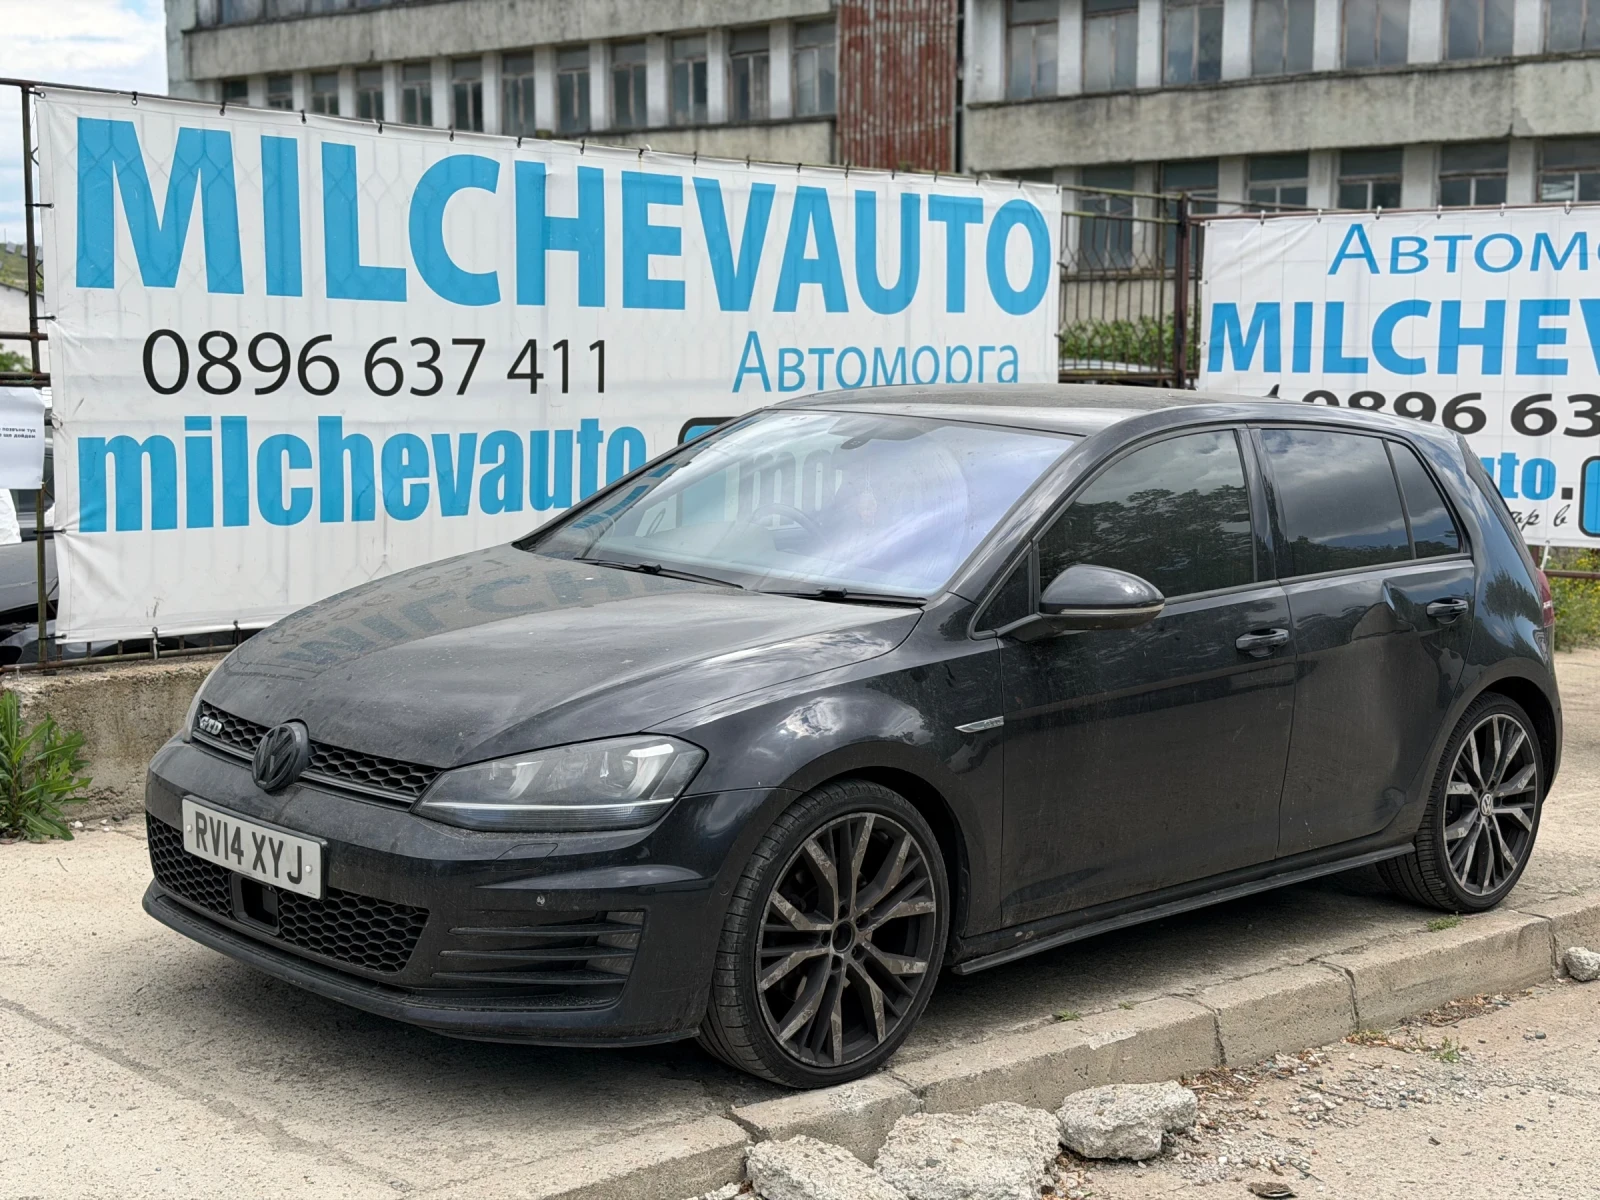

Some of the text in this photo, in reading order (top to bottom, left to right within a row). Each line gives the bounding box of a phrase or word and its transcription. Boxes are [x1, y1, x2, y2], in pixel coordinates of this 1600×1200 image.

[76, 117, 1051, 316] MILCHEVAUTO
[1327, 223, 1600, 276] Автом
[142, 329, 605, 397] 0896 637 411
[732, 330, 1019, 393] Автоморга
[78, 415, 646, 533] milchevauto
[199, 716, 223, 736] GTD
[195, 810, 302, 885] RV14 XYJ
